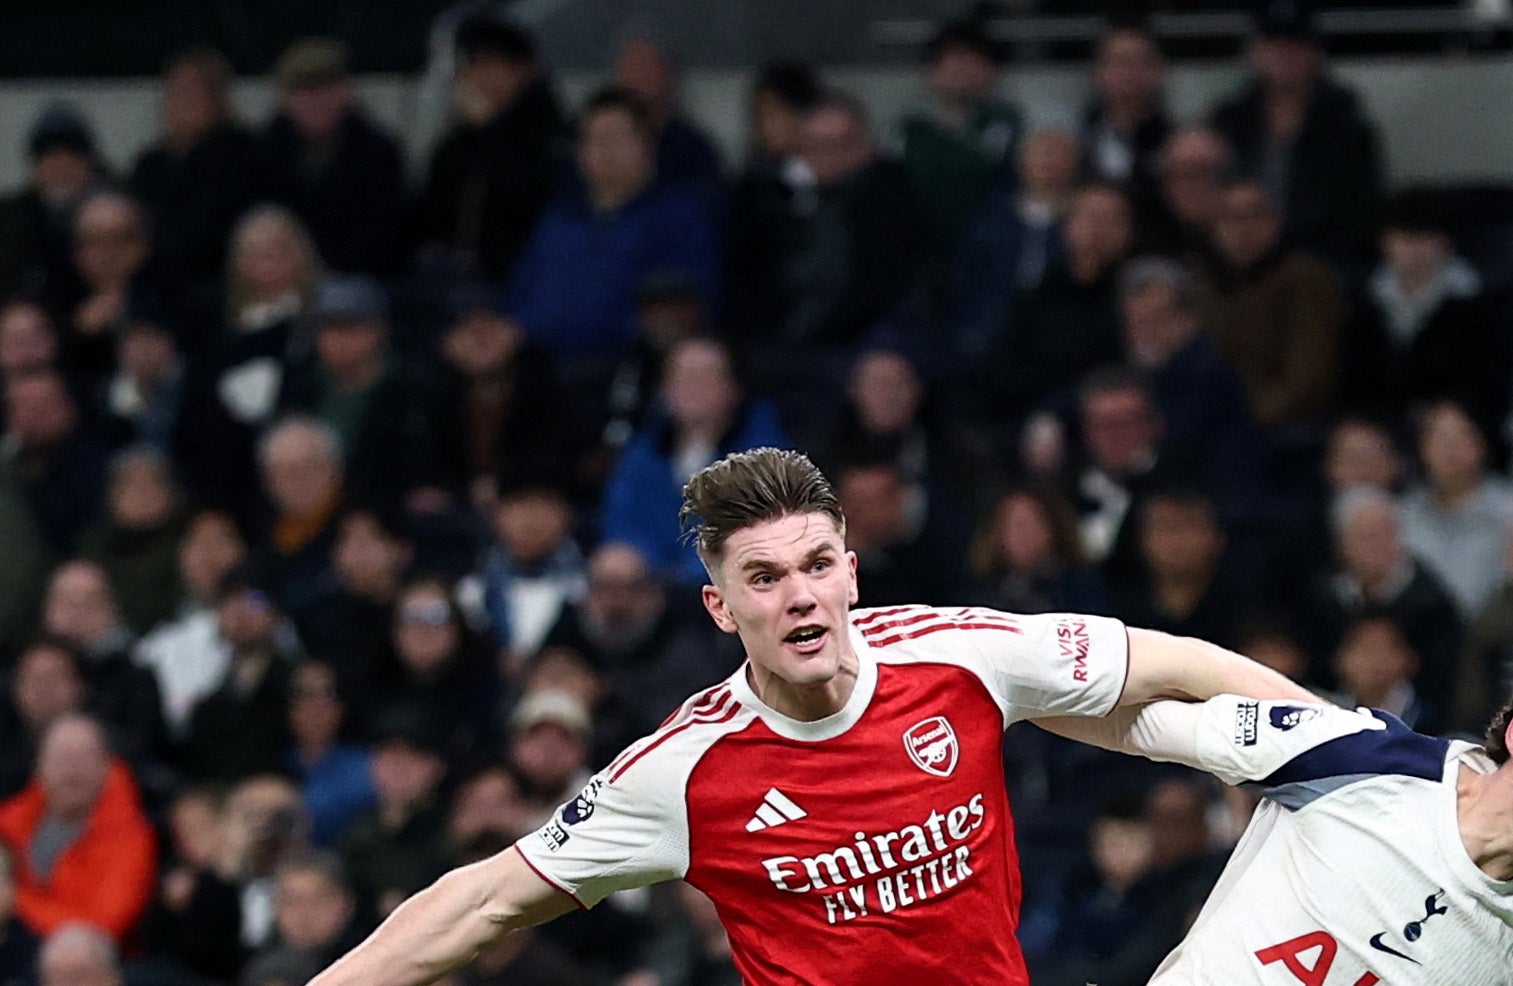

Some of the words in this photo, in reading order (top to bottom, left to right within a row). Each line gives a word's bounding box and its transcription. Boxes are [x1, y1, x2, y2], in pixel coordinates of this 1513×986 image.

[1073, 618, 1089, 682] RWAN
[761, 793, 984, 893] Emirates
[823, 884, 868, 924] FLY
[877, 845, 974, 914] BETTER
